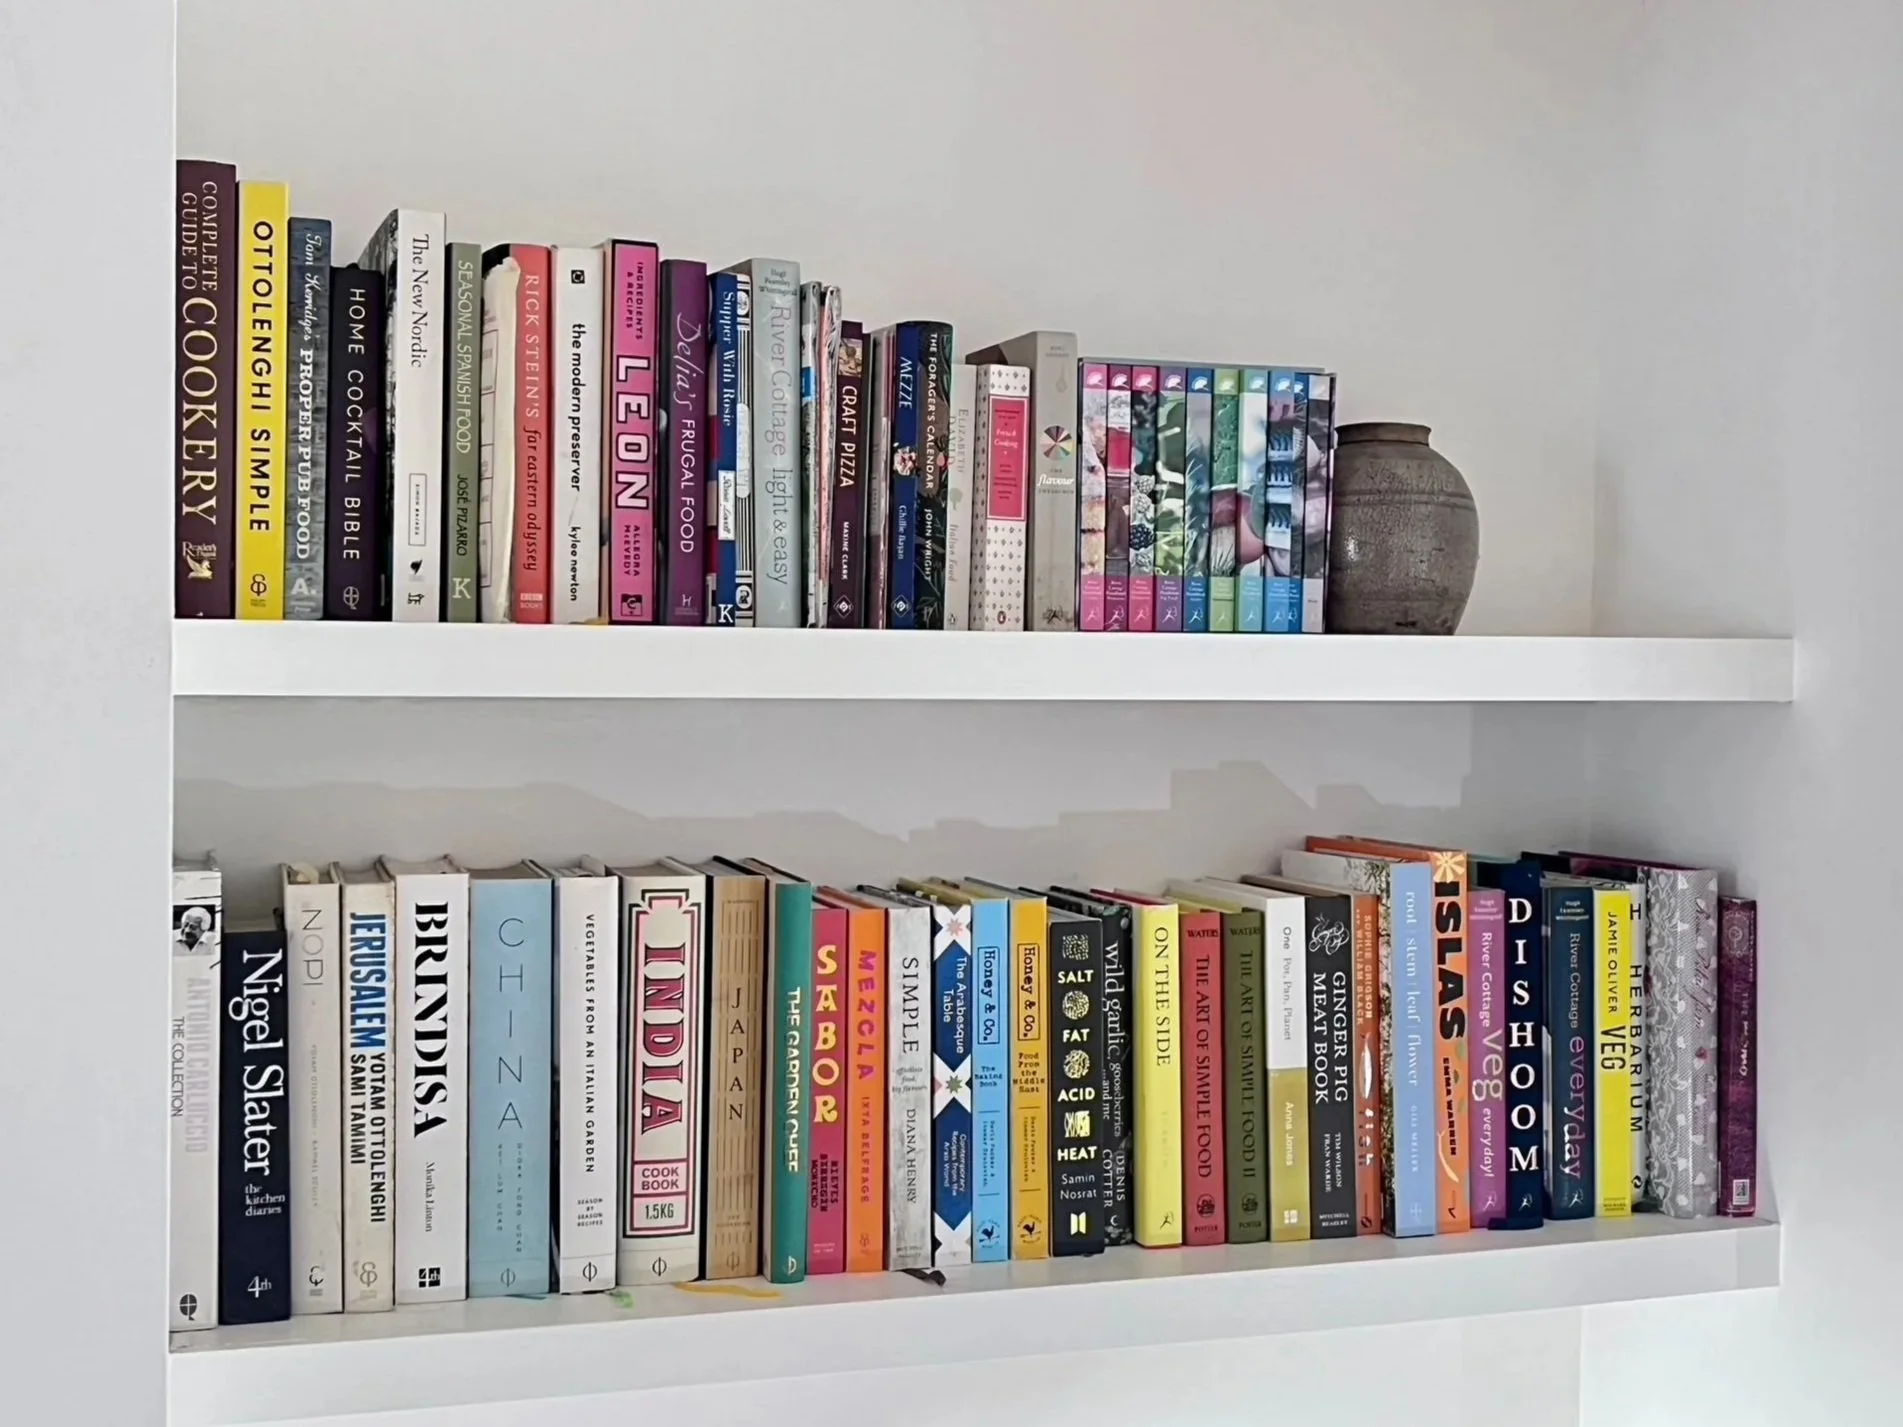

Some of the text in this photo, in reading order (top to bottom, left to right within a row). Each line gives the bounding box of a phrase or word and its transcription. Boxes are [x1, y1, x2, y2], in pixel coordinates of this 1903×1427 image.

[182, 193, 197, 290] GUIDE TO
[202, 181, 217, 291] COMPLETE
[411, 234, 428, 368] The New Nordic
[526, 275, 539, 418] RICK STEIN'S
[626, 282, 634, 328] RECIPES
[771, 306, 791, 365] River
[250, 221, 273, 531] OTTOLENGHI SIMPLE
[456, 261, 472, 453] SEASONAL SPANISH FOOD
[673, 312, 704, 412] Delia's
[718, 291, 736, 426] Supper With Rosie
[899, 356, 913, 410] MEZZE
[926, 358, 937, 421] FORAGER'S
[182, 296, 218, 526] COOKERY
[297, 349, 313, 559] PROPER PUB FOOD
[343, 289, 365, 560] HOME COCKTAIL BIBLE
[568, 323, 586, 492] the modern preserver
[616, 355, 650, 509] LEON
[765, 370, 791, 455] Cottage
[840, 386, 857, 487] CRAFT PIZZA
[523, 427, 541, 571] far eastern odyssey
[680, 419, 695, 552] FRUGAL FOOD
[765, 469, 793, 517] light
[925, 425, 935, 489] CALENDAR
[456, 474, 471, 556] JOSÉ PIZARRO
[766, 536, 787, 585] easy
[924, 509, 933, 580] JOHN WRIGHT
[452, 578, 471, 599] K
[718, 603, 733, 623] K
[302, 909, 323, 985] NOPI
[350, 912, 386, 1048] JERUSALEM
[1058, 969, 1094, 984] SALT
[1103, 940, 1125, 994] wild
[1406, 891, 1418, 977] root stem
[1434, 881, 1466, 1040] ISLAS
[1479, 932, 1493, 1027] River Cottage
[1568, 933, 1581, 1029] River Cottage
[1608, 912, 1618, 1013] JAMIE OLIVER
[414, 902, 448, 1138] BRINDISA
[498, 918, 524, 1130] CHINA
[857, 950, 878, 1079] MEZCLA
[902, 957, 919, 1053] SIMPLE
[943, 990, 954, 1023] Table
[954, 957, 967, 1054] The Arabesque
[981, 950, 996, 1041] Honey & Co.
[1021, 947, 1036, 1038] Honey & Co.
[1154, 927, 1171, 1067] ON THE SIDE
[1282, 926, 1292, 1041] One Planet
[170, 1016, 185, 1117] THE COLLECTION
[228, 948, 285, 1176] Nigel Slater
[585, 914, 595, 1173] VEGETABLES FROM AN ITALIAN GARDEN
[642, 942, 686, 1135] INDIA
[729, 988, 744, 1120] JAPAN
[786, 987, 800, 1114] THE GARDEN
[812, 945, 840, 1123] SABOR
[1018, 1052, 1039, 1060] Food
[1062, 1028, 1090, 1042] FAT
[1196, 955, 1212, 1178] THE ART OF SIMPLE FOOD
[1240, 950, 1256, 1178] THE ART OF SIMPLE FOOD II
[1313, 973, 1328, 1104] MEAT BOOK
[1332, 971, 1348, 1102] GINGER PIG
[1472, 1028, 1503, 1101] veg
[1508, 898, 1539, 1172] DISHOOM
[1601, 1026, 1626, 1070] VEG
[1630, 964, 1642, 1132] HERBARIUM
[351, 1054, 366, 1164] SAMI TAMIMI
[370, 1052, 386, 1222] YOTAM OTTOLENGHI
[1057, 1087, 1095, 1102] ACID
[1285, 1102, 1295, 1166] Anna Jones
[1443, 1057, 1457, 1155] EMMA WARREN
[1559, 1036, 1585, 1179] everyday
[425, 1161, 436, 1232] Monika Linton
[641, 1179, 679, 1190] BOOK
[642, 1167, 679, 1178] COOK
[861, 1096, 870, 1203] IXTA BELFRAGE
[907, 1108, 916, 1204] DIANA HENRY
[1057, 1146, 1098, 1162] HEAT
[1060, 1189, 1097, 1199] Nosrat
[1061, 1174, 1095, 1185] Samin
[1102, 1149, 1113, 1208] COTTER
[1116, 1154, 1125, 1201] DENIS
[245, 1193, 286, 1205] kitchen
[245, 1206, 282, 1216] diaries
[645, 1204, 674, 1220] 1.5KG
